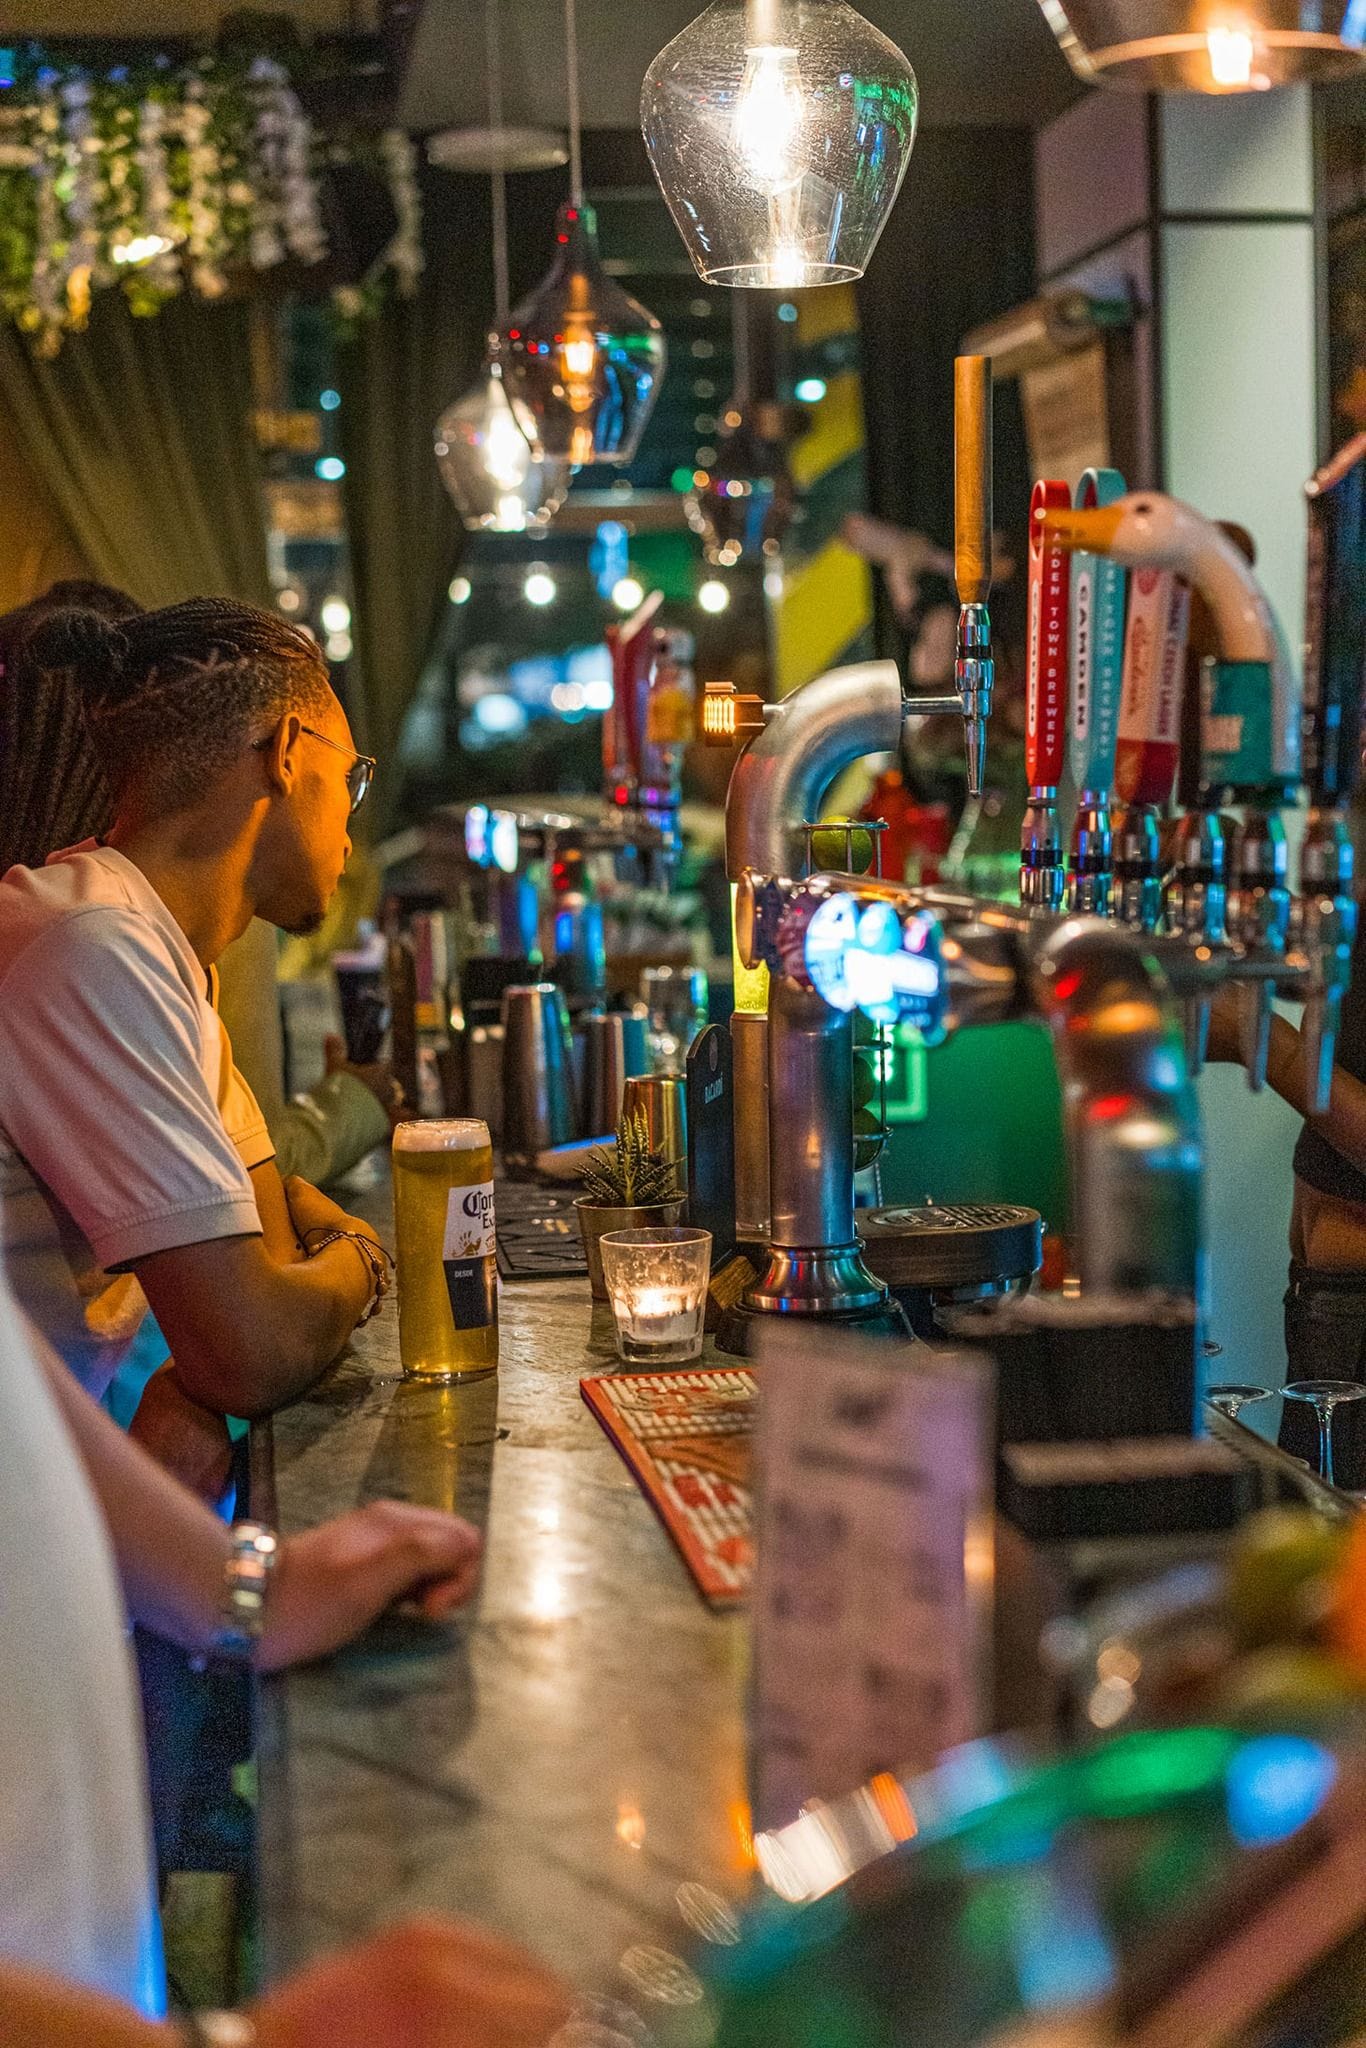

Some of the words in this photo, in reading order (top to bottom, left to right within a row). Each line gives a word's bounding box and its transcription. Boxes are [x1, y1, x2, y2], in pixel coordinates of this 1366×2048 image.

[1050, 531, 1062, 596] AMDEN
[1047, 606, 1060, 656] TOWN
[1045, 667, 1058, 757] BREWERY
[462, 1190, 496, 1220] Cor
